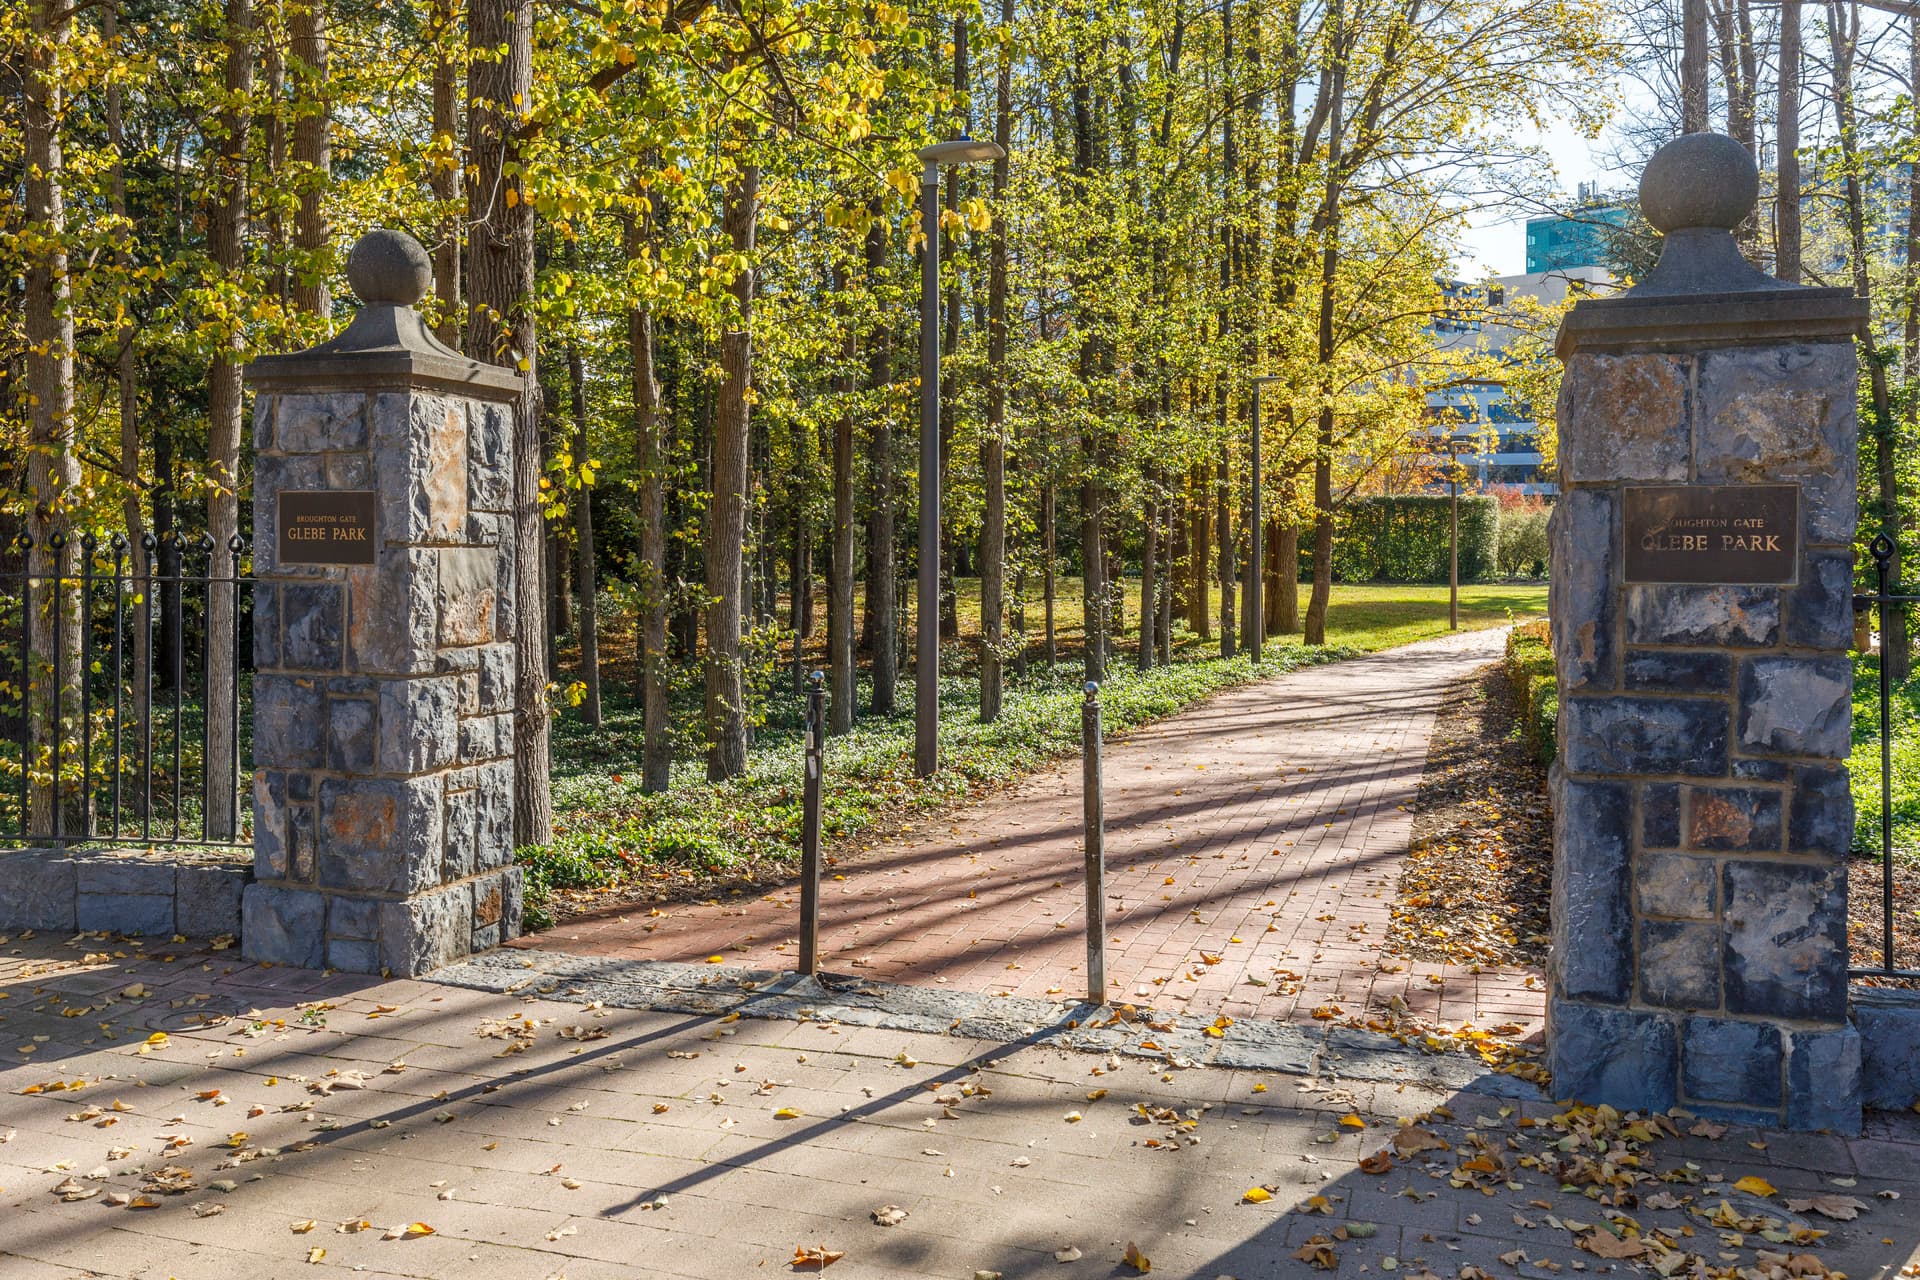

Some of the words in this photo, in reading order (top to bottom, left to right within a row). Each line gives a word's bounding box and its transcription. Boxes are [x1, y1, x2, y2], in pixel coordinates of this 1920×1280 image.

[296, 515, 337, 523] BROUGHTON
[340, 515, 357, 523] GATE
[1657, 518, 1728, 528] OUGHTON
[1733, 518, 1765, 528] GATE
[287, 527, 326, 540] GLEBE
[333, 527, 366, 540] PARK
[1641, 534, 1708, 551] GLEBE
[1720, 534, 1781, 551] PARK
